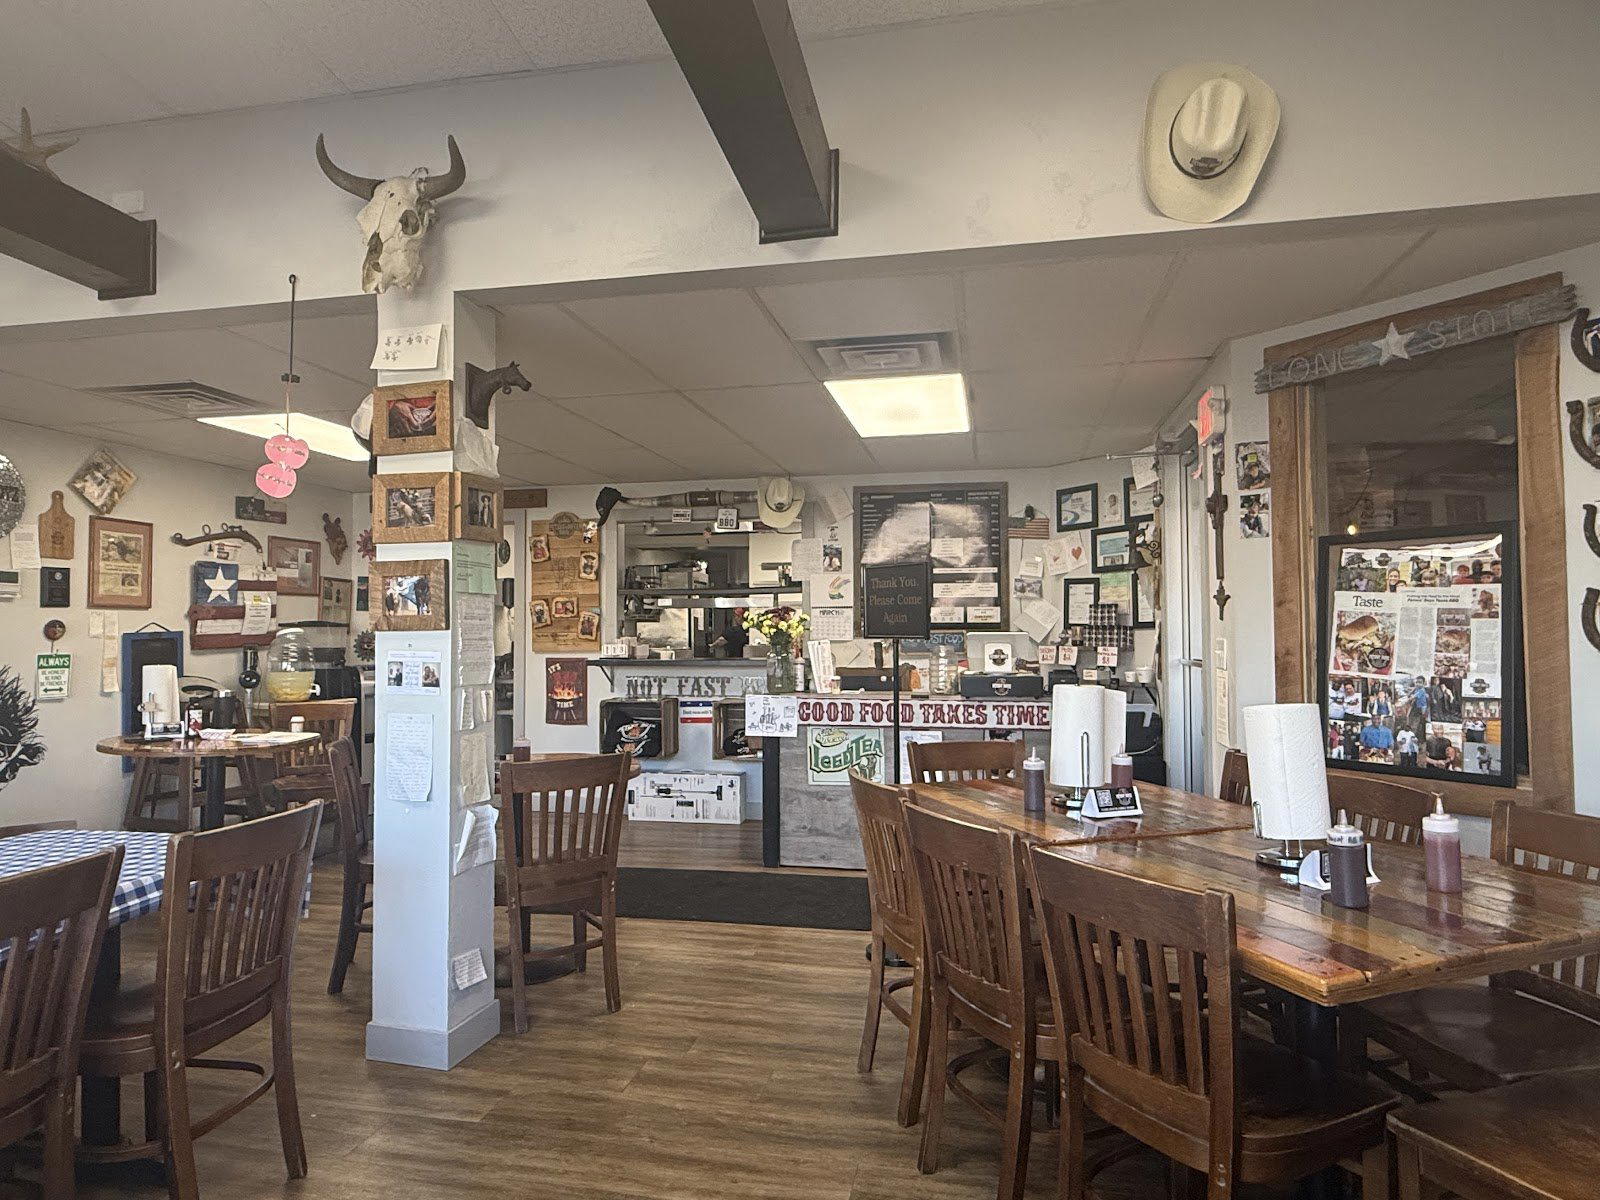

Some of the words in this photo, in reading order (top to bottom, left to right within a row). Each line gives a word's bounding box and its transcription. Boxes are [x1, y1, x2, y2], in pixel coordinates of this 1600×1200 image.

[870, 577, 897, 589] Thank
[870, 594, 895, 606] Please
[897, 594, 921, 605] Come
[1352, 596, 1383, 608] Taste
[883, 612, 907, 625] Again
[39, 657, 70, 667] ALWAYS
[626, 676, 668, 698] NOT
[677, 676, 731, 697] FAST
[556, 701, 574, 709] TIME
[798, 702, 854, 722] GOOD
[920, 703, 988, 725] TAKES
[992, 704, 1049, 726] TIME
[846, 733, 882, 766] TEA
